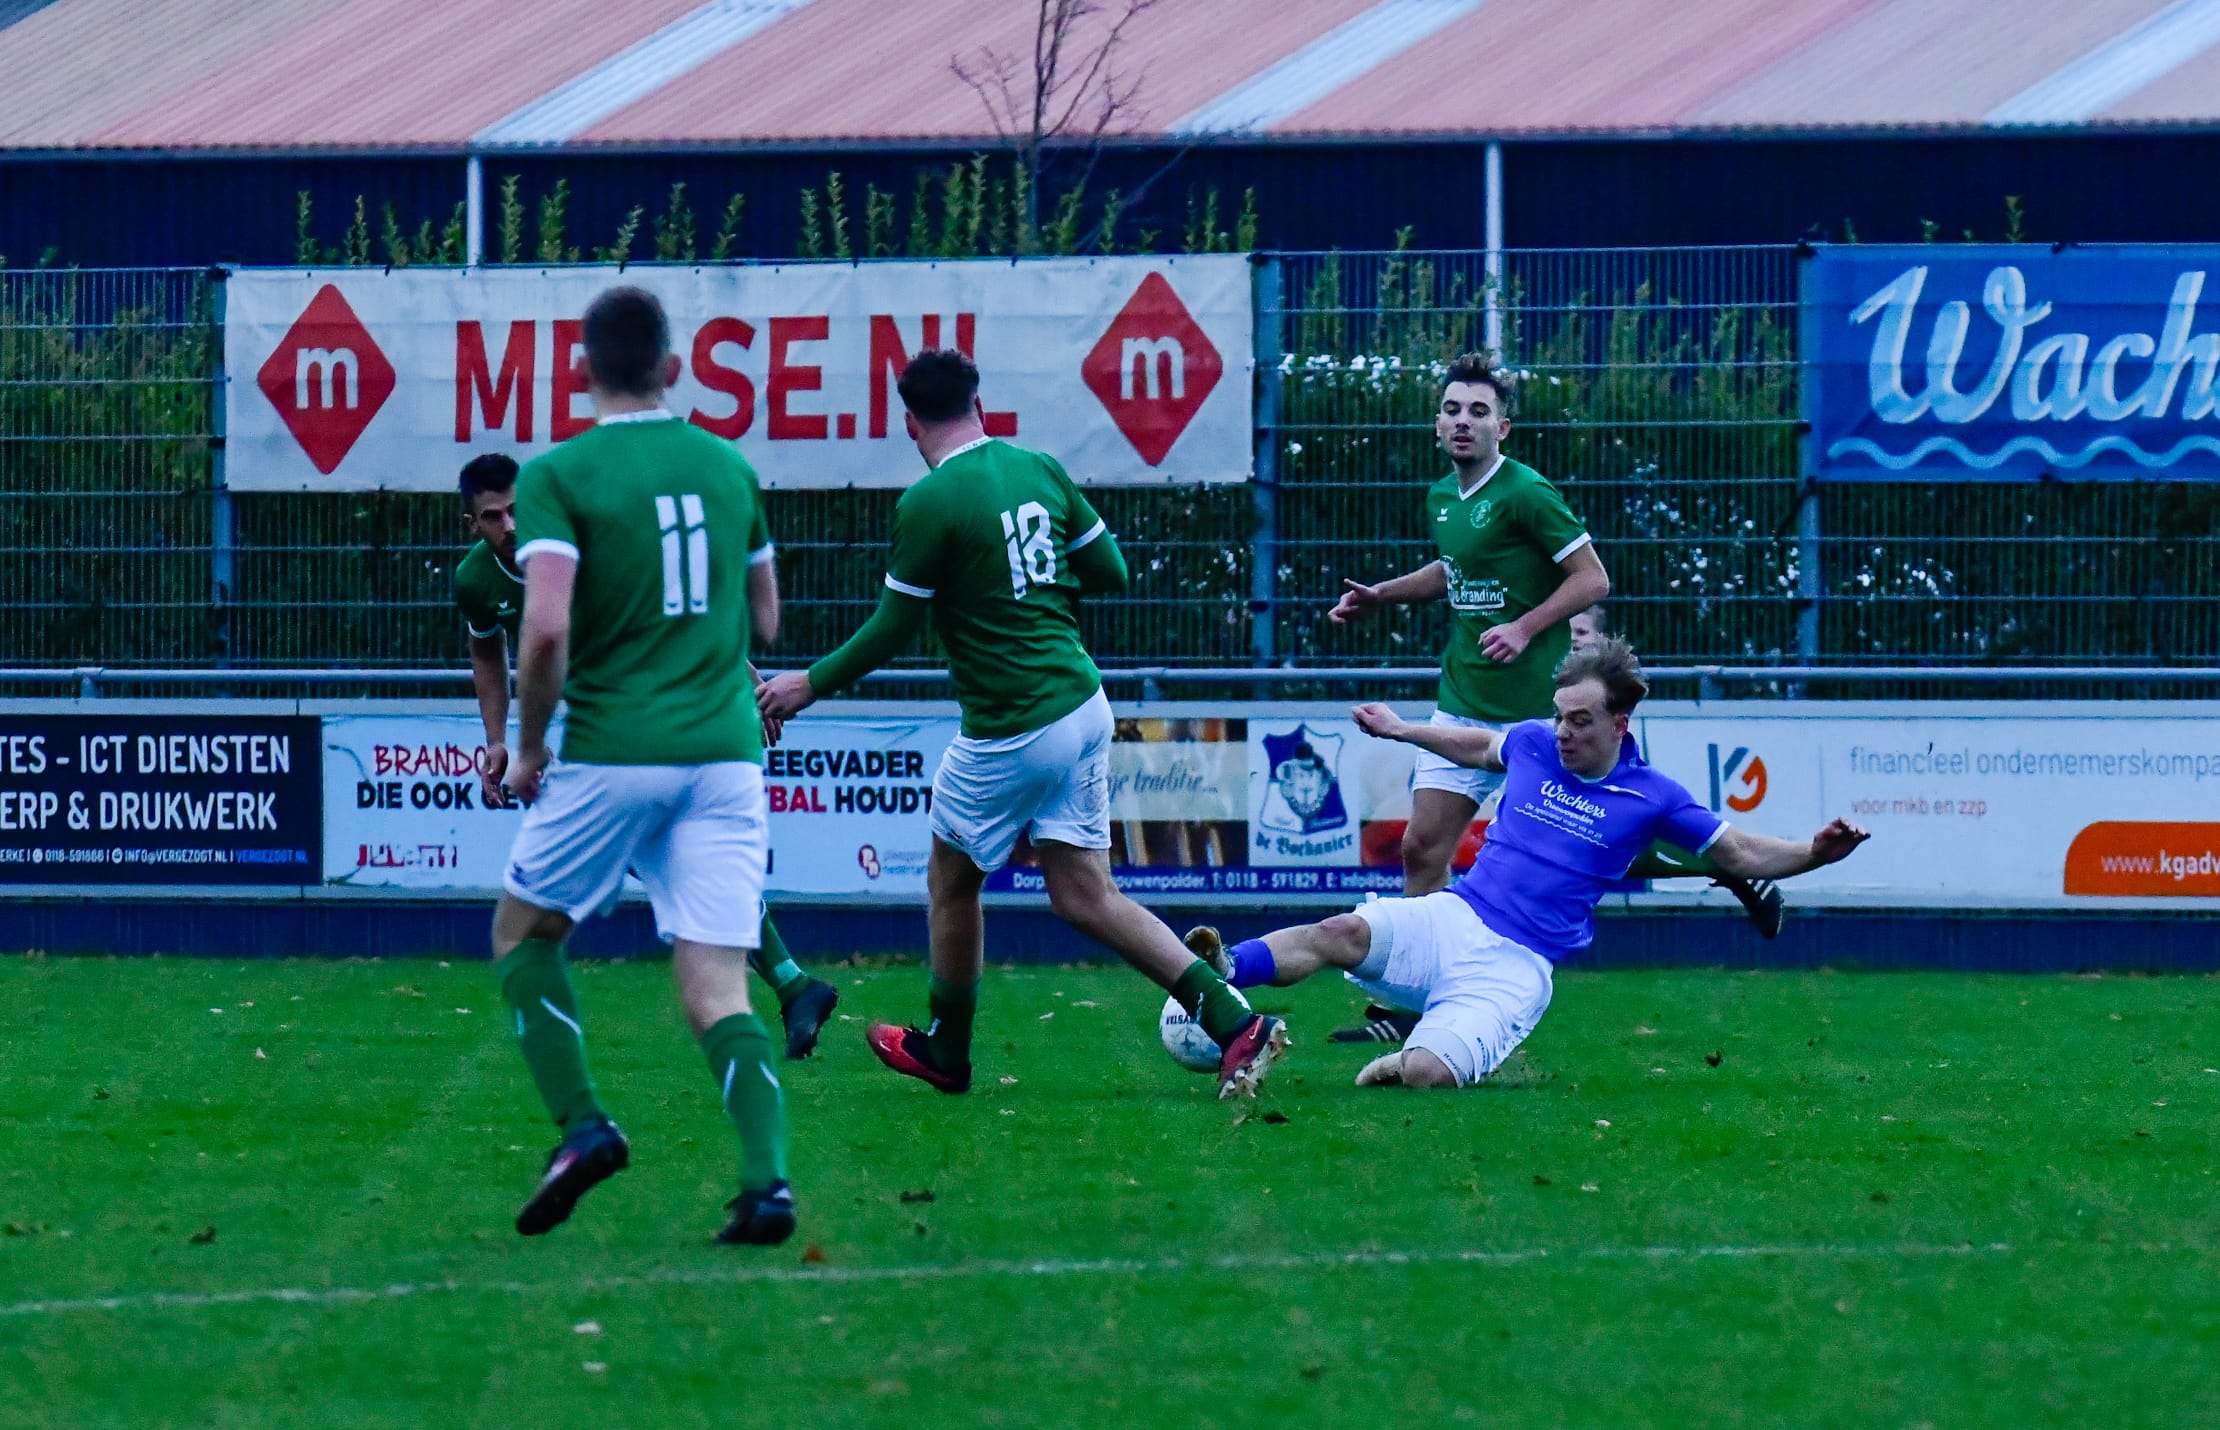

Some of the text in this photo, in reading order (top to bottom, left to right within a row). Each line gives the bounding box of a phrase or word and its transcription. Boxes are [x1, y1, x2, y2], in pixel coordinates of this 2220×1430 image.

[455, 312, 1018, 443] MESE.NL
[655, 494, 709, 615] 11
[1000, 501, 1056, 600] 18
[80, 736, 128, 774] ICT
[138, 736, 290, 774] DIENSTEN
[764, 750, 924, 778] EEGVADER
[1850, 746, 2220, 782] financieel ondernemerskompa
[0, 791, 278, 830] ERP & DRUKWERK
[357, 781, 403, 809] DIE
[410, 781, 474, 809] OOK
[764, 785, 827, 813] BAL
[835, 785, 933, 814] HOUDT
[1540, 780, 1607, 818] Wachters
[1933, 800, 1954, 815] en
[1958, 800, 1987, 816] zzp
[1013, 872, 1046, 890] Dorp
[1225, 872, 1258, 888] 0118
